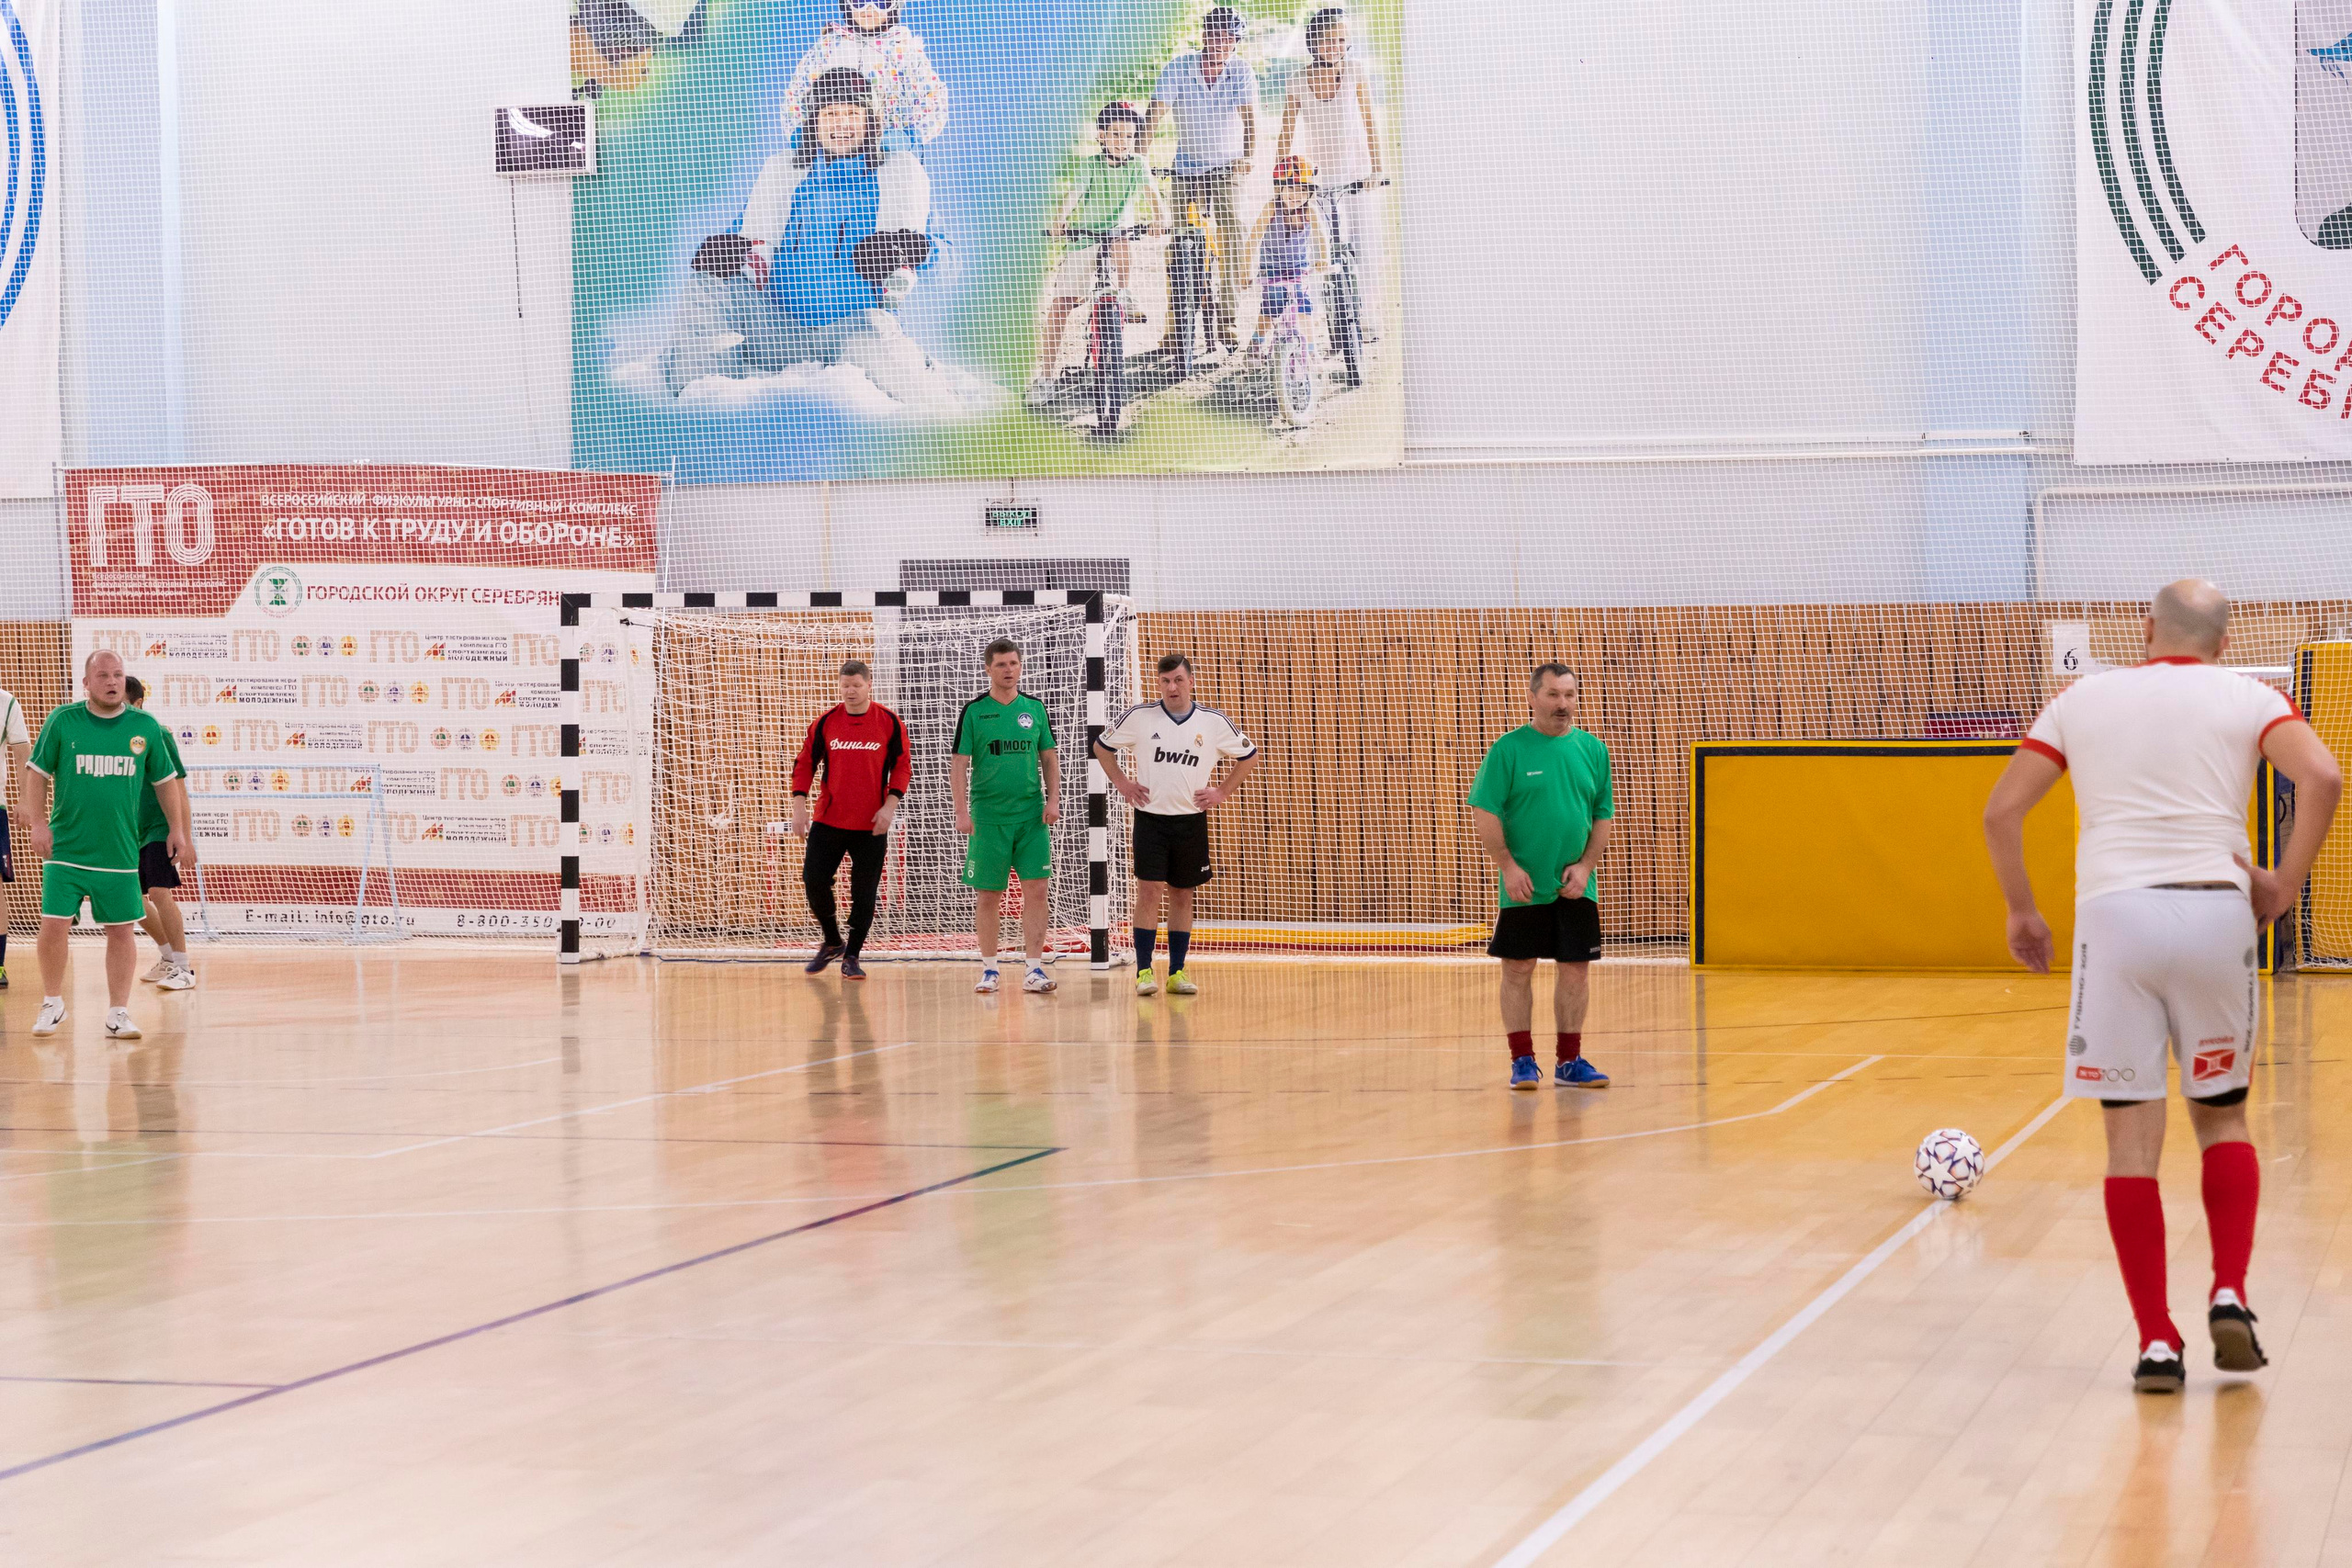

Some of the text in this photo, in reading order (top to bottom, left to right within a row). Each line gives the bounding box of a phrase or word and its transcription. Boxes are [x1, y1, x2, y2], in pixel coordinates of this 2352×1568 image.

[2169, 276, 2352, 419] СЕРЕБ
[262, 492, 637, 516] ВСЕРОССИЙСКИЙ ФИЗКУЛЬТУРНО-СПОРТИВНЫЙ КОМПЛЕКС
[87, 483, 215, 567] ГТО
[262, 517, 636, 547] «ГОТОВ К ТРУДУ И ОБОРОНЕ»
[307, 583, 562, 606] ГОРОДСКОЙ ОКРУГ СЕРЕБРЯН
[232, 629, 280, 661] ГТО
[369, 629, 420, 662] ГТО
[512, 633, 561, 666] ГТО
[2064, 647, 2079, 671] 6
[163, 674, 211, 706] ГТО
[301, 675, 348, 706] ГТО
[441, 677, 490, 710] ГТО
[233, 719, 279, 751] ГТО
[368, 720, 419, 753] ГТО
[511, 724, 560, 757] ГТО
[830, 738, 881, 750] Динамо
[1003, 739, 1032, 751] МОСТ
[75, 754, 136, 777] РАДОСТЬ
[1154, 746, 1199, 767] bwin
[439, 767, 490, 800] ГТО
[582, 771, 632, 804] ГТО
[232, 809, 280, 841] ГТО
[510, 815, 560, 848] ГТО
[245, 908, 310, 923] E-mail:
